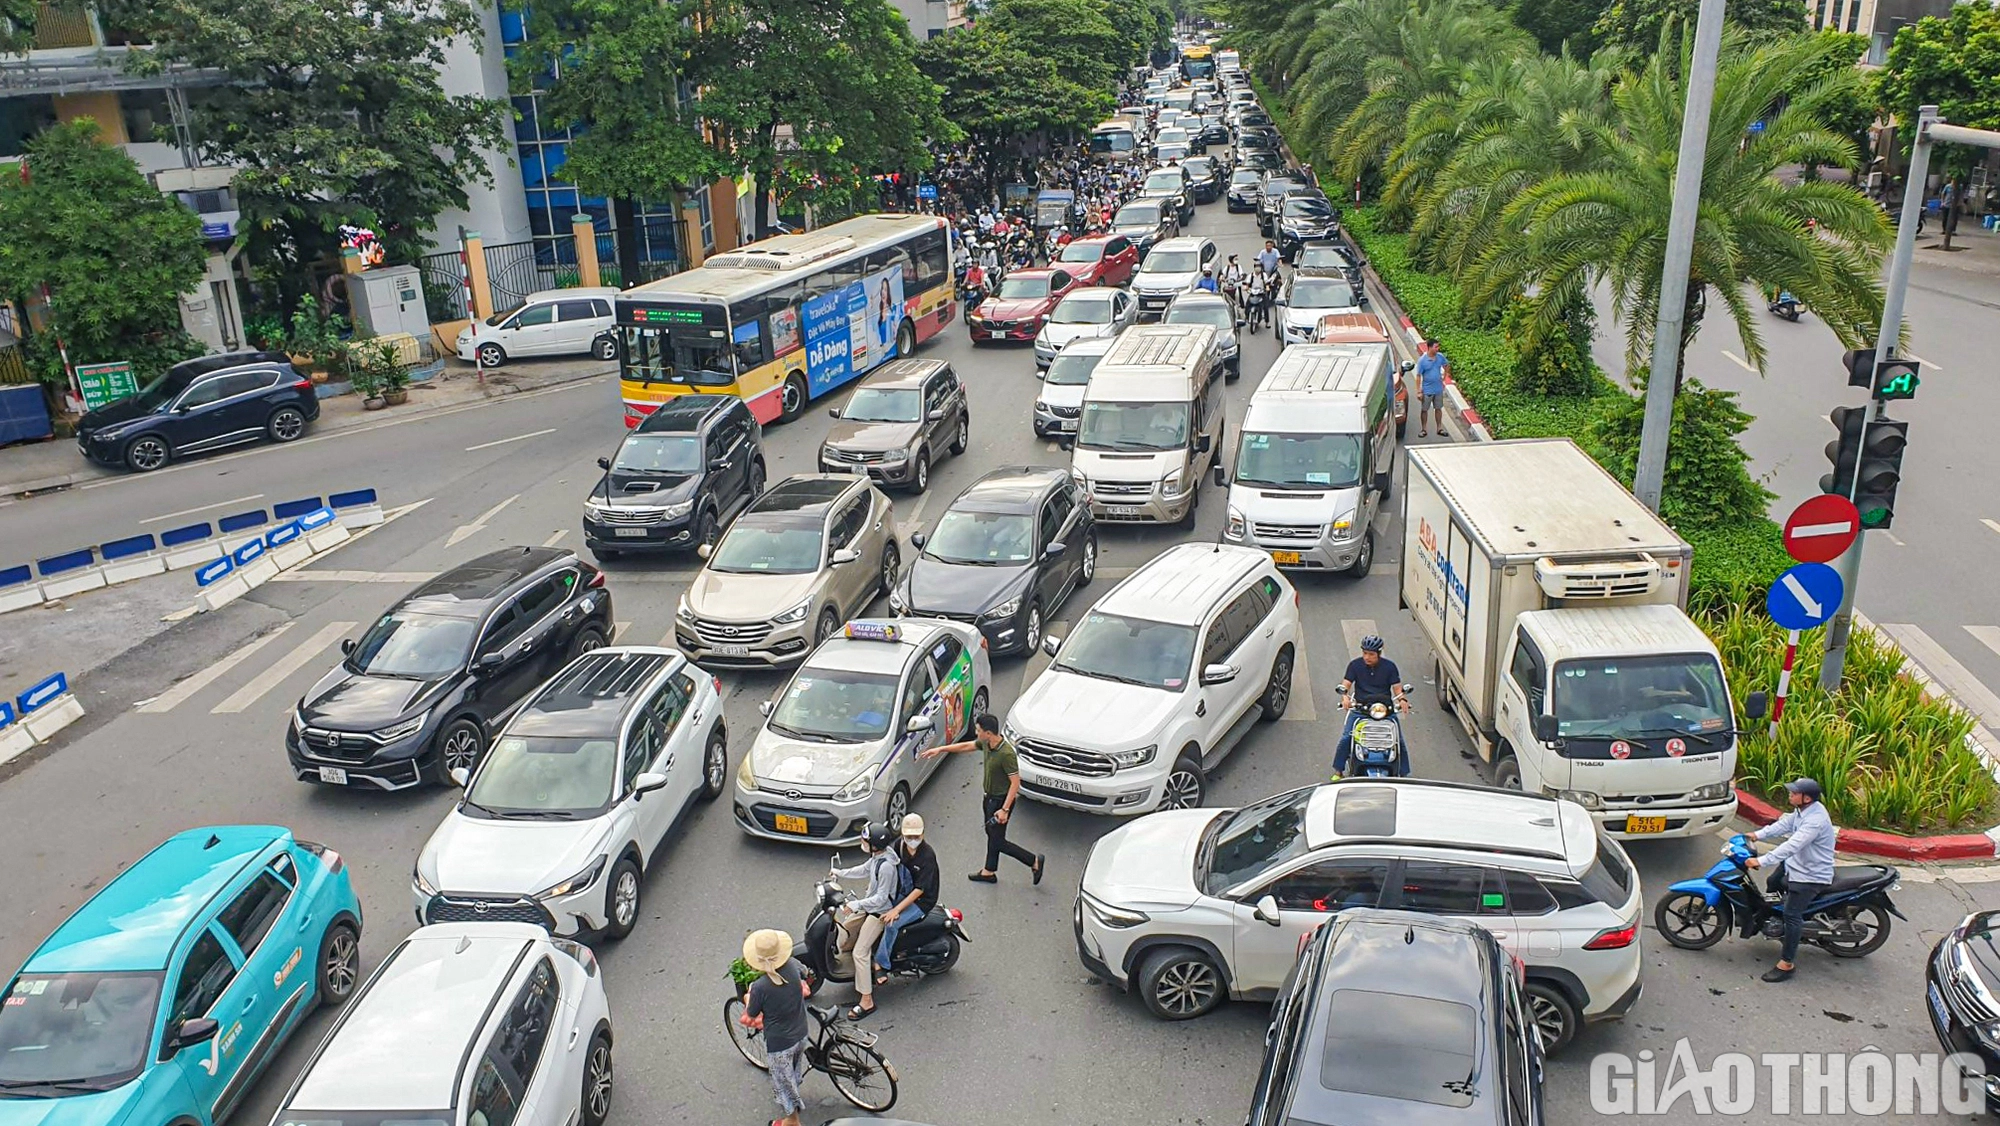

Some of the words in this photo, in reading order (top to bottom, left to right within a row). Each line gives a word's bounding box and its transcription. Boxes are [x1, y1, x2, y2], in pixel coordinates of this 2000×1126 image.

[810, 341, 824, 368] Dễ
[824, 338, 848, 361] Dàng
[1419, 516, 1437, 553] ABA
[1638, 816, 1655, 825] 51C
[4, 996, 27, 1006] TAXI
